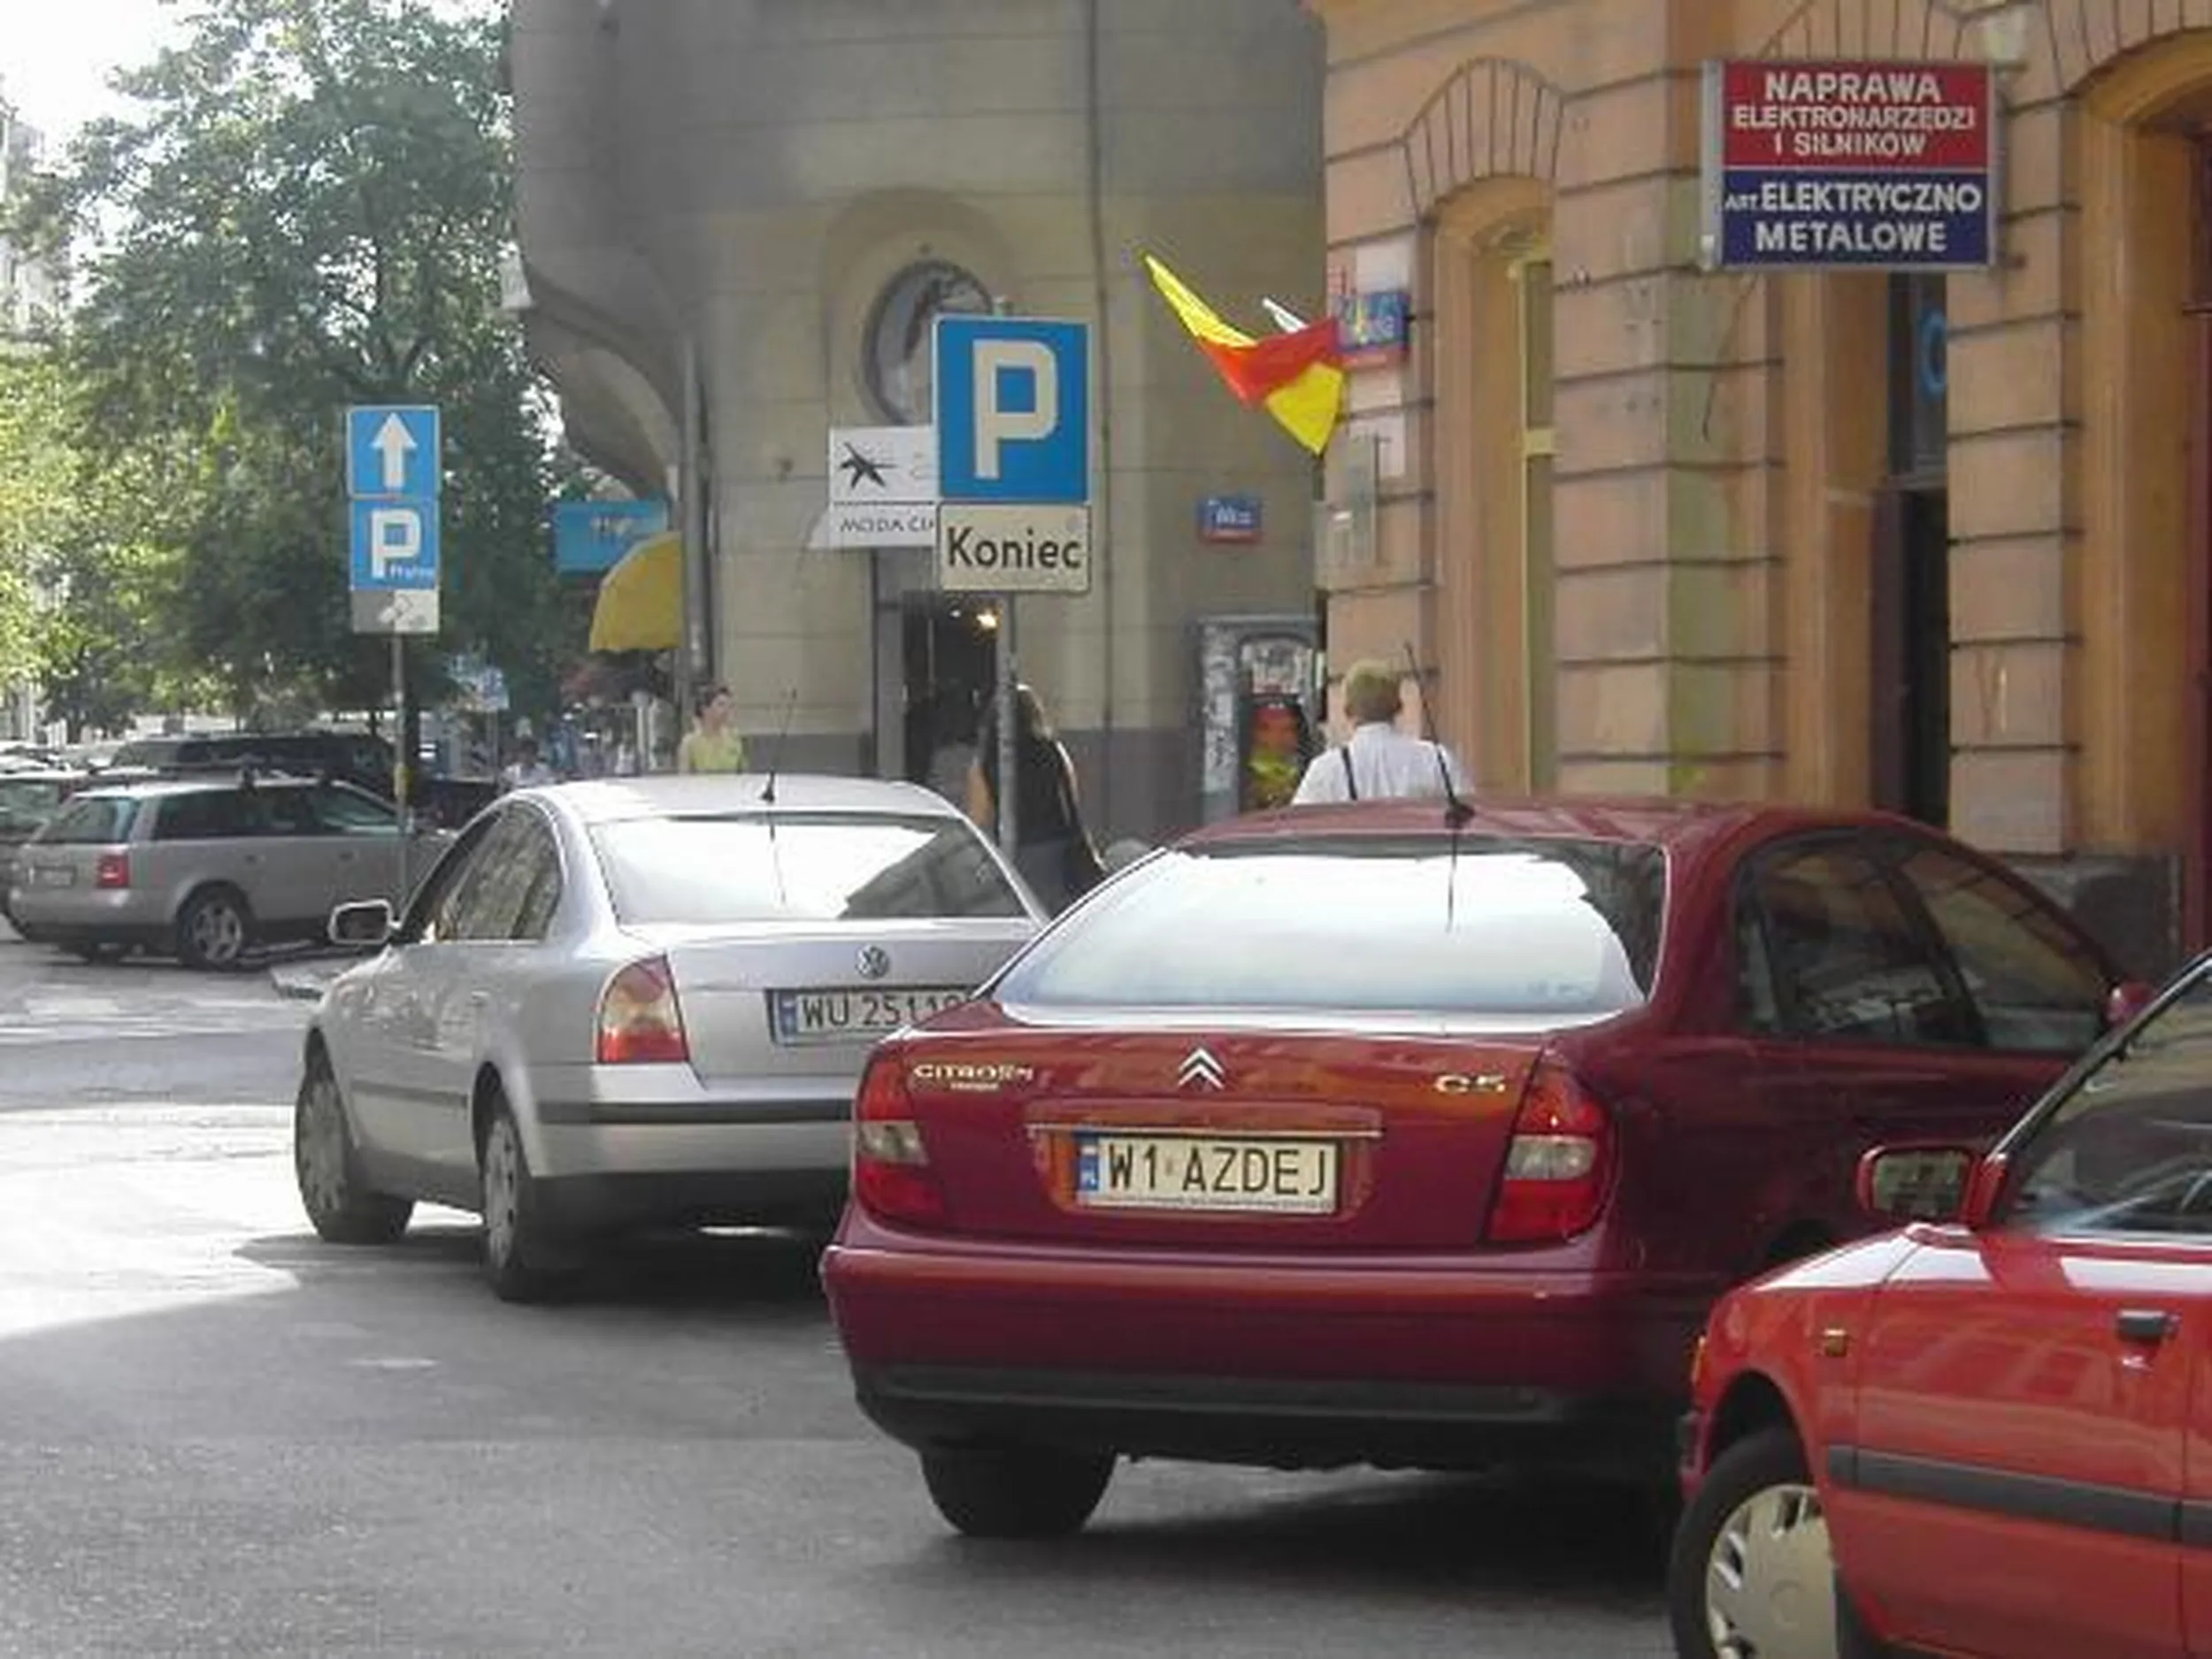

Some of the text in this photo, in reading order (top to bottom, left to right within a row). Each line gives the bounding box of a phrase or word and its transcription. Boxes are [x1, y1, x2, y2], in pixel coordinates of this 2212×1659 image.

[1765, 73, 1941, 103] NAPRAWA
[1774, 134, 1783, 156] I
[1762, 182, 1981, 212] ELEKTRYCZNO
[1755, 222, 1947, 251] METALOWE
[973, 338, 1058, 480] P
[840, 518, 904, 533] MODA
[372, 508, 421, 579] P
[947, 526, 1082, 569] Koniec
[803, 996, 849, 1028] WU
[1109, 1142, 1156, 1190] W1
[1182, 1146, 1326, 1195] AZDEJ
